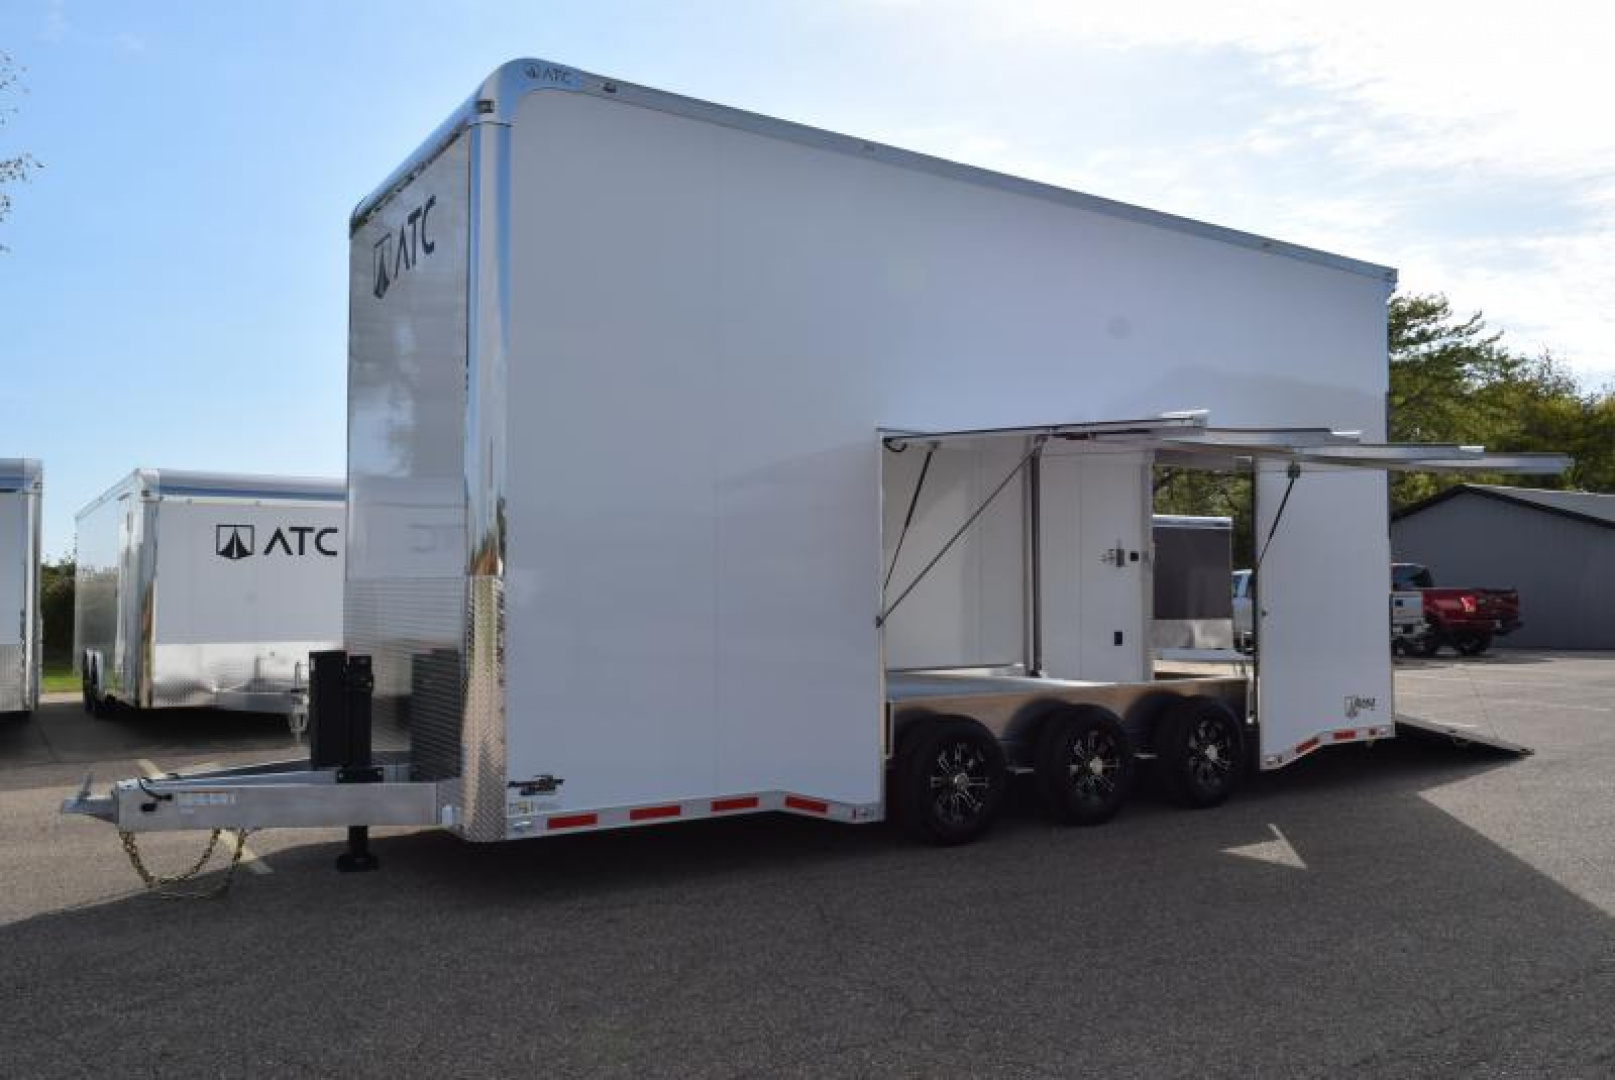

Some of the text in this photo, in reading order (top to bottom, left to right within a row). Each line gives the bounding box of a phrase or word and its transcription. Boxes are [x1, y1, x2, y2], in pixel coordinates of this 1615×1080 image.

[543, 67, 572, 84] ATC
[394, 195, 436, 279] ATC
[263, 526, 338, 556] ATC
